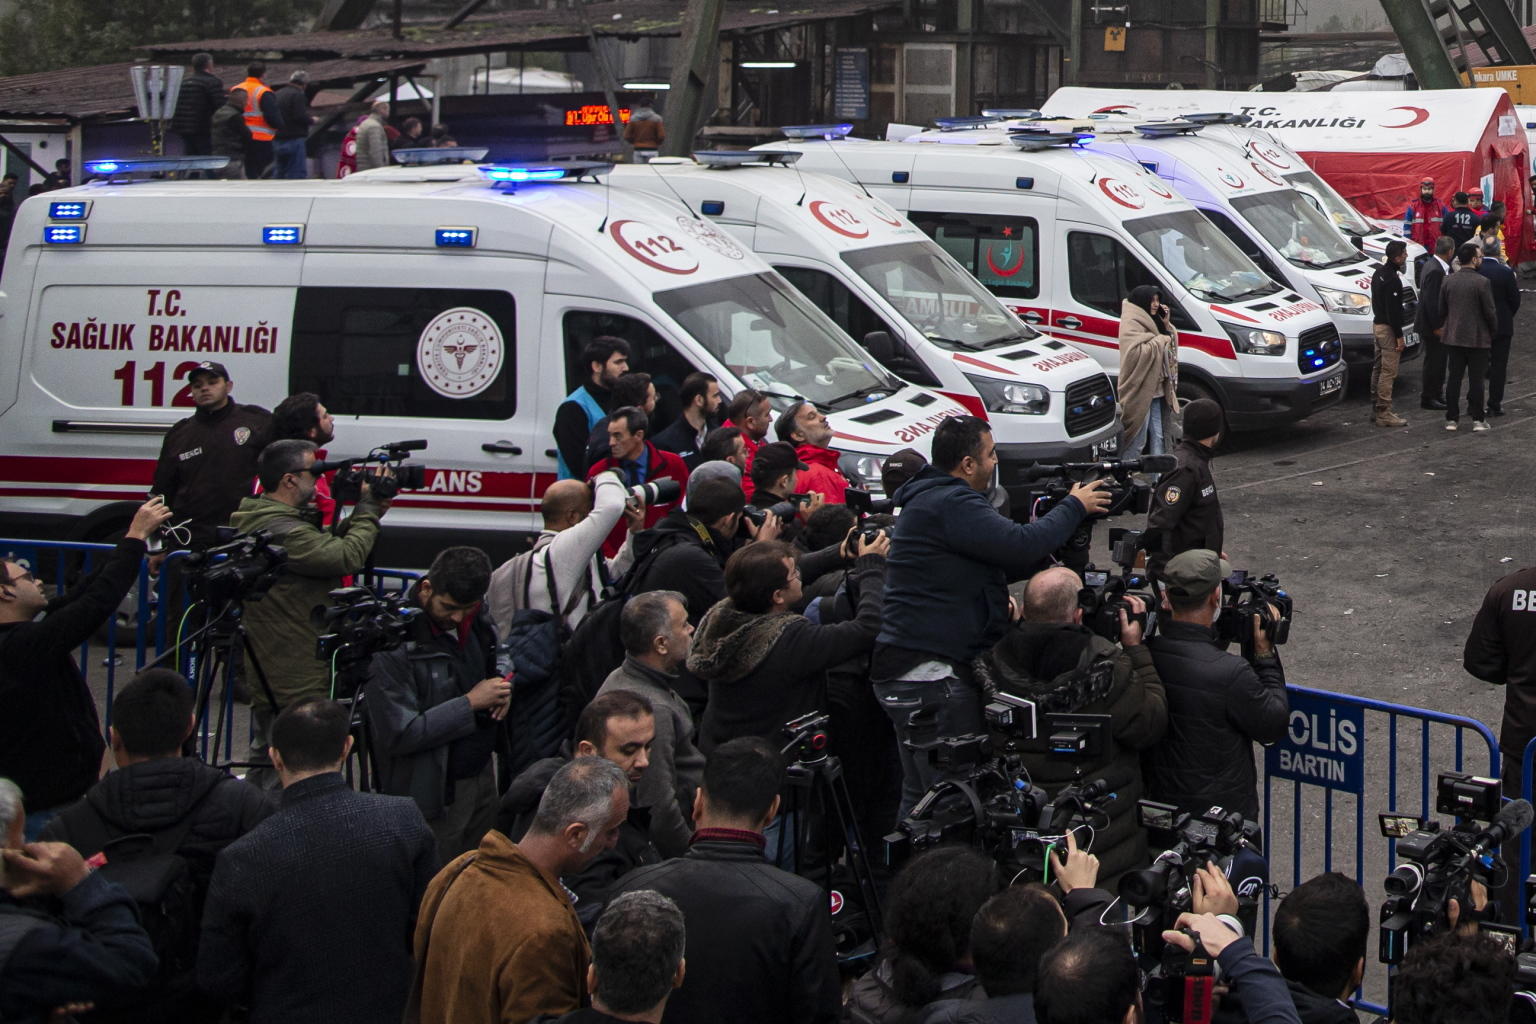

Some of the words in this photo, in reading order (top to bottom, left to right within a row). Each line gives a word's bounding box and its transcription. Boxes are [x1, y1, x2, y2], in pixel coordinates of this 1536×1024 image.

[1473, 71, 1495, 82] nkara
[1496, 70, 1518, 81] UMKE
[1240, 106, 1281, 116] T.C.
[1238, 117, 1366, 129] AKANLIĞI
[828, 209, 860, 225] 112
[1454, 213, 1471, 225] 112
[635, 235, 685, 257] 112
[147, 289, 187, 317] T.C.
[50, 317, 136, 351] SAĞLIK
[149, 320, 278, 354] BAKANLIĞI
[1288, 708, 1357, 755] OLİS
[1280, 749, 1345, 782] BARTIN
